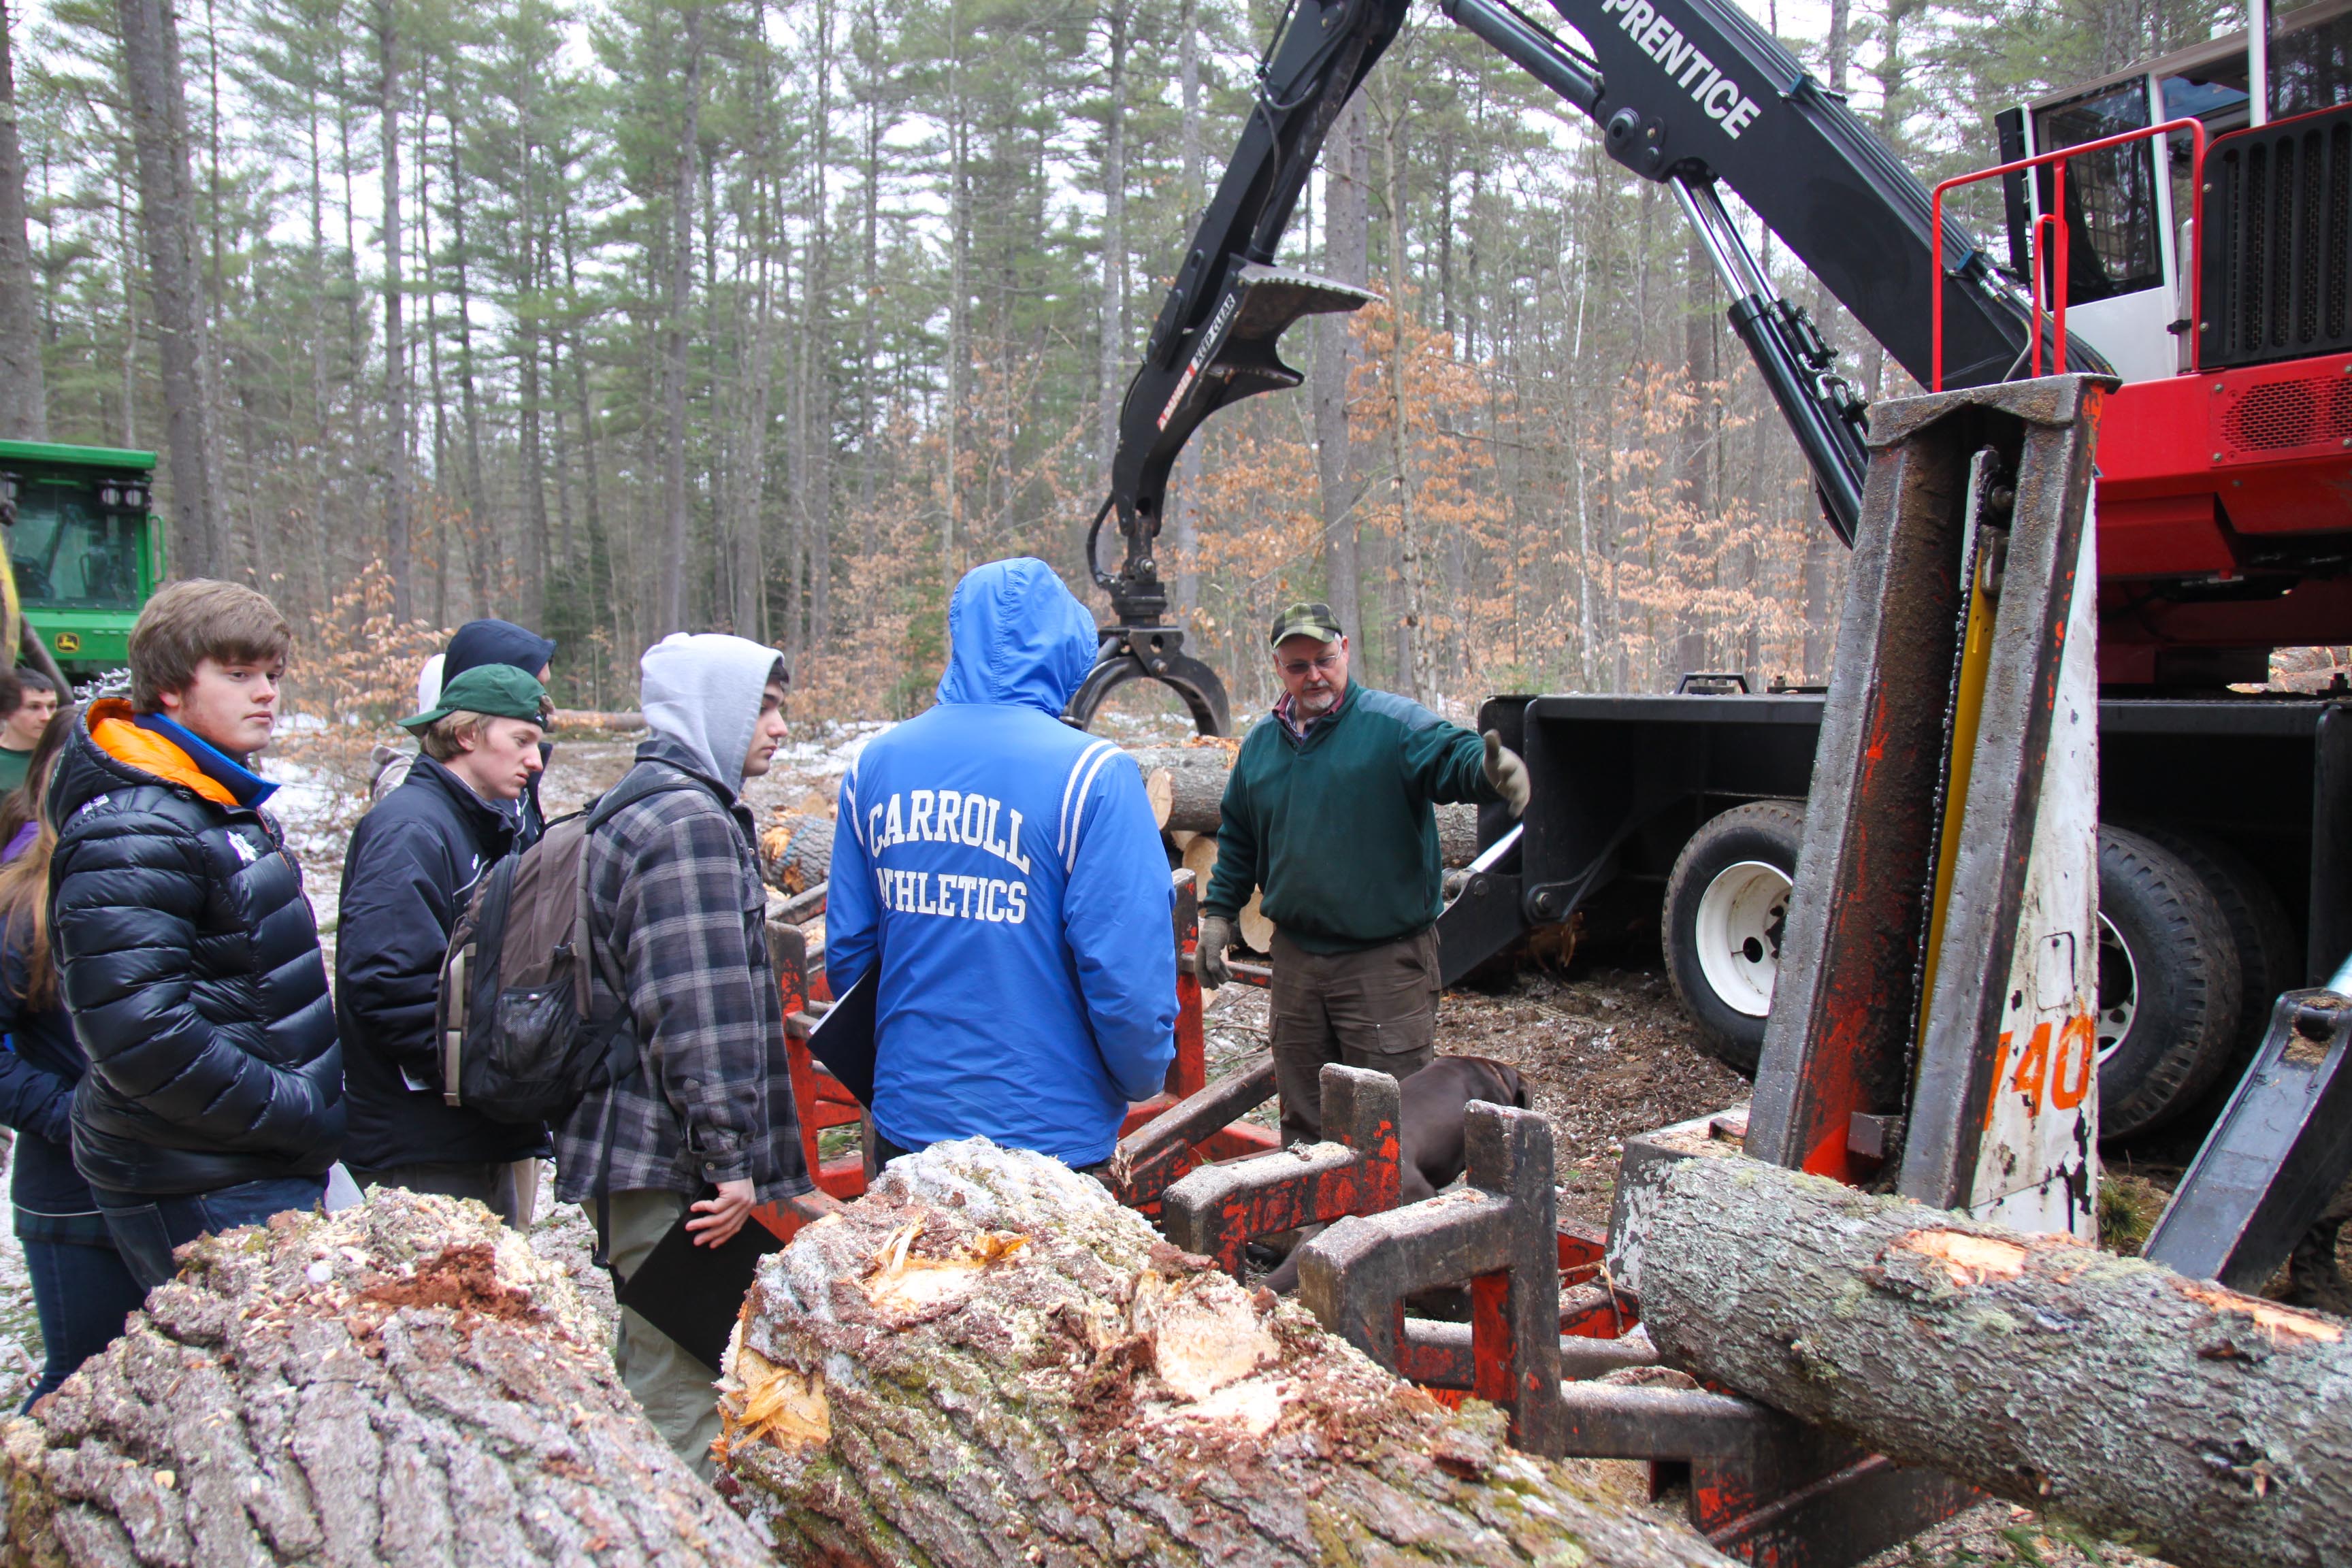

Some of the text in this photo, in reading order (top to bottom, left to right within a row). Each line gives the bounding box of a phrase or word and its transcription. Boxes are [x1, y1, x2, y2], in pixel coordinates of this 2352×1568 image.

[1194, 331, 1212, 363] KEEP
[1212, 297, 1234, 333] CLEAR
[868, 789, 1030, 876] CARROLL
